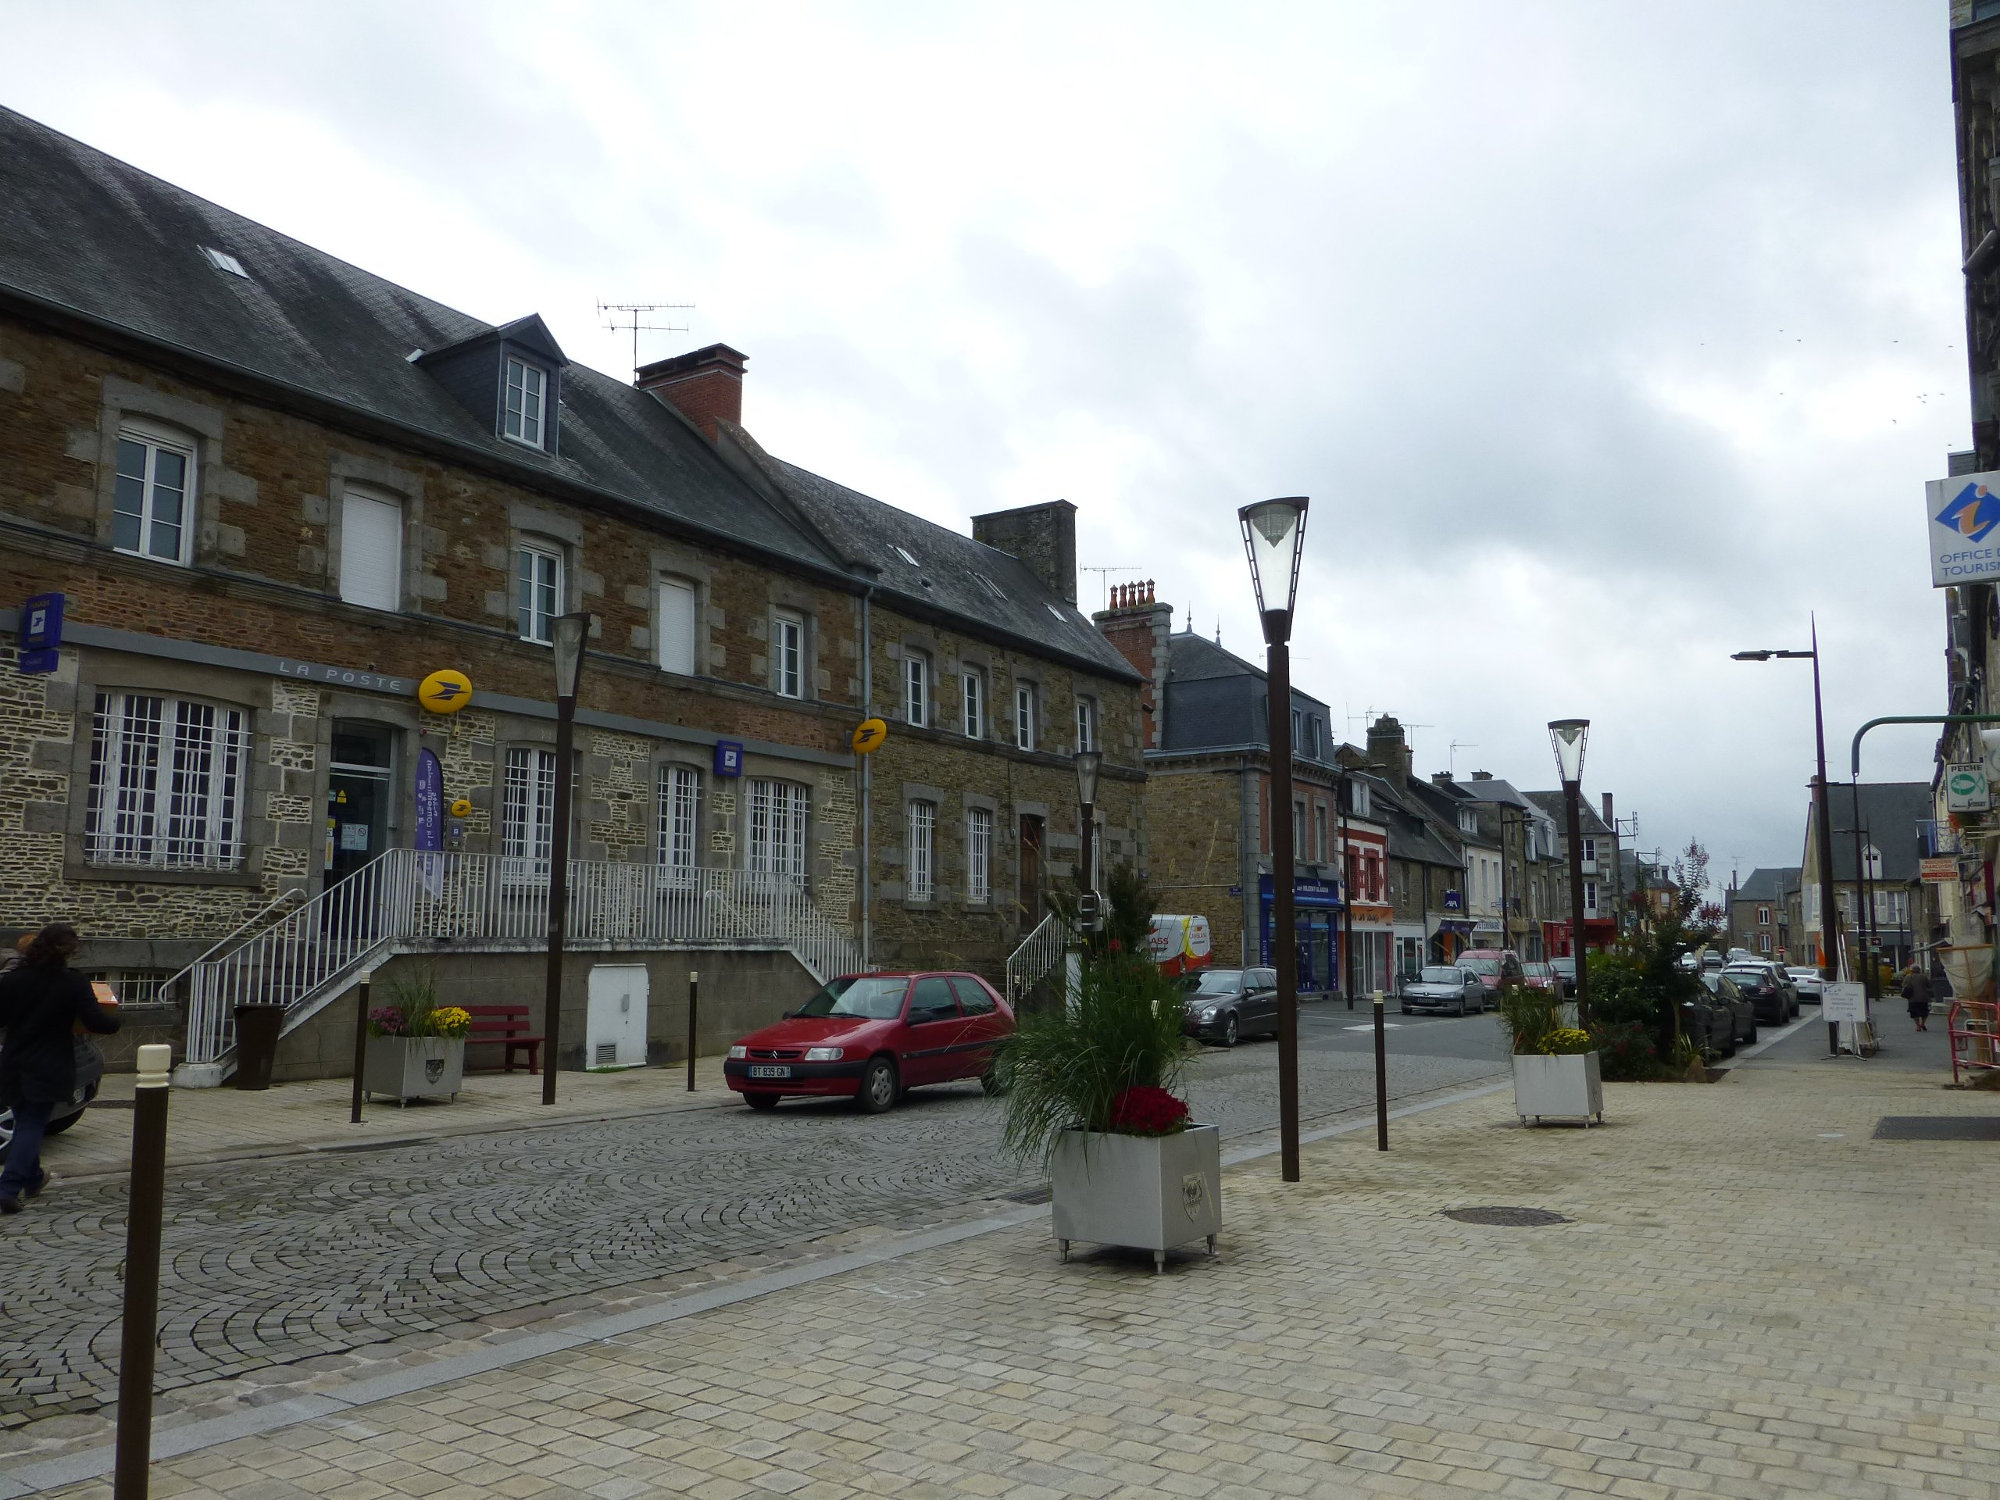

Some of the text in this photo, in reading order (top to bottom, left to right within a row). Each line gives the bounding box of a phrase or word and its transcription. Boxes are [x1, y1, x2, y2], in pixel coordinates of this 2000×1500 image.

[1940, 549, 1992, 564] OFFICE
[279, 661, 401, 691] LA POSTE
[1444, 900, 1458, 908] AXA
